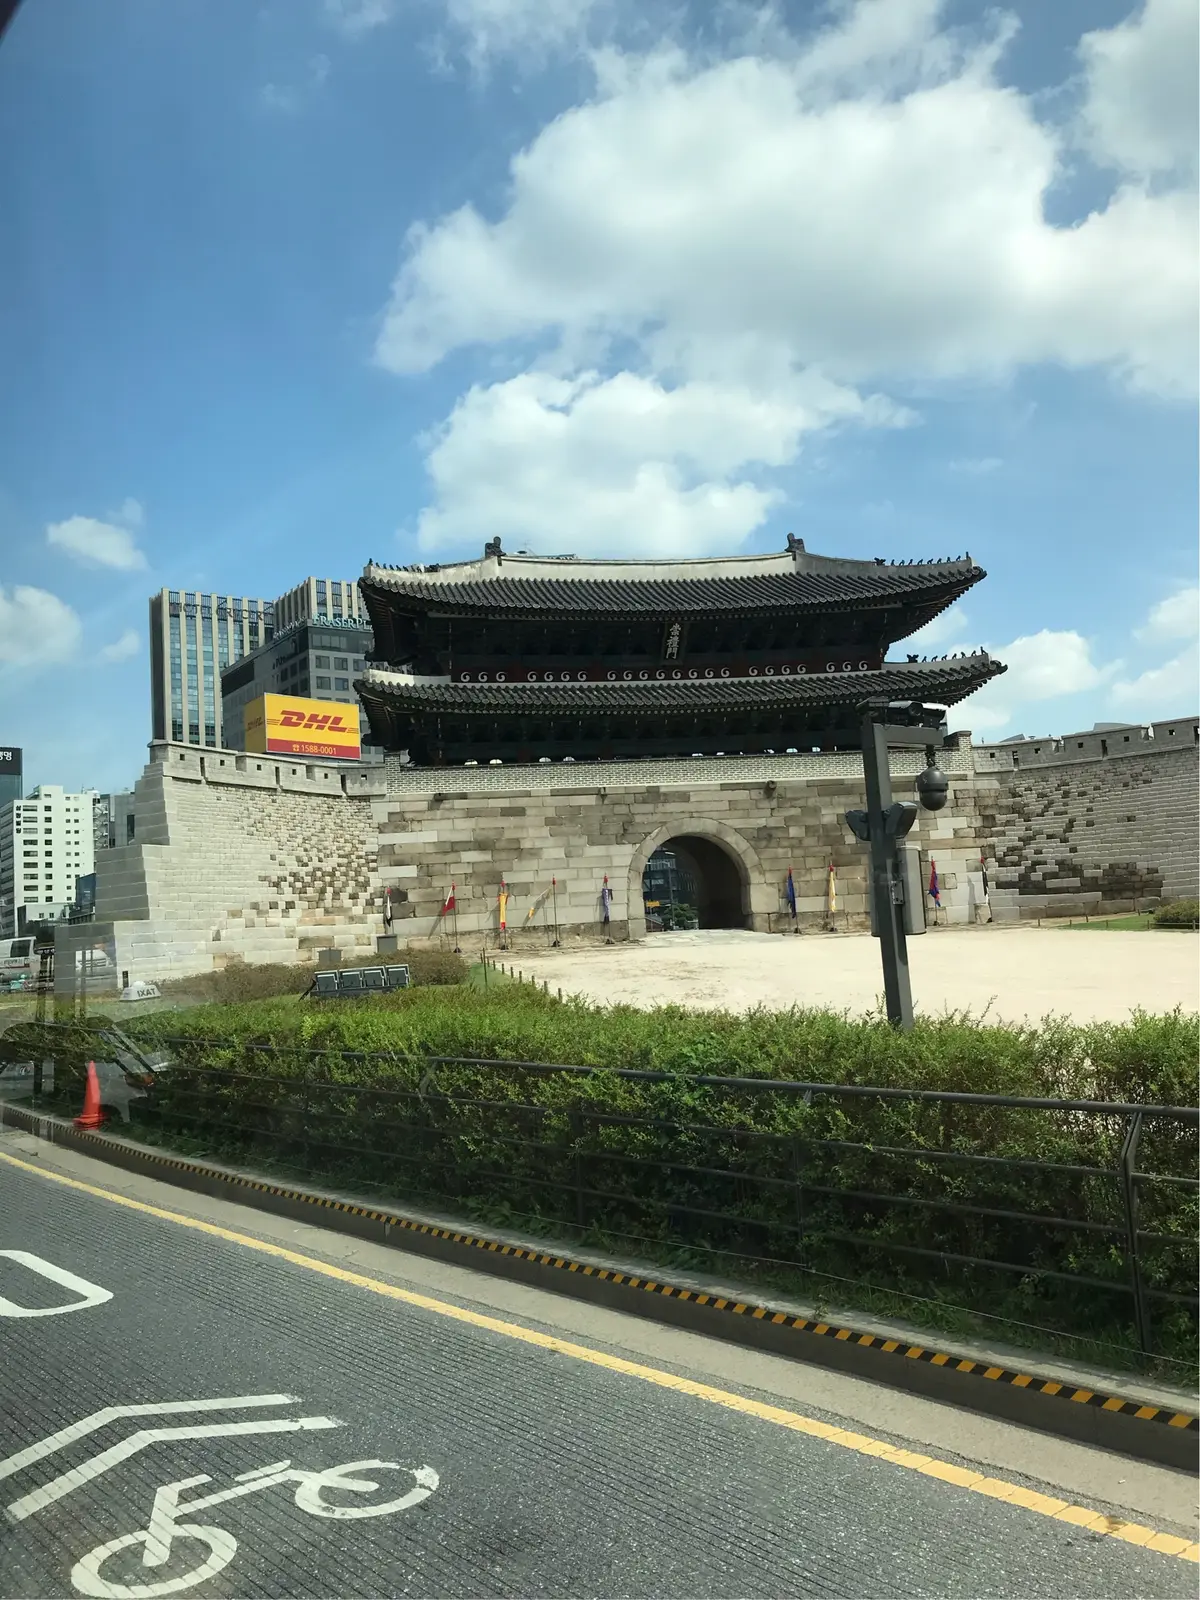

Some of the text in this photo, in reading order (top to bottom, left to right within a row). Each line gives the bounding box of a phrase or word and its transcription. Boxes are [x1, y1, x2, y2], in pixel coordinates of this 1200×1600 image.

[312, 613, 355, 629] FRASER
[280, 709, 347, 733] DHL
[301, 744, 337, 755] 1588-0001
